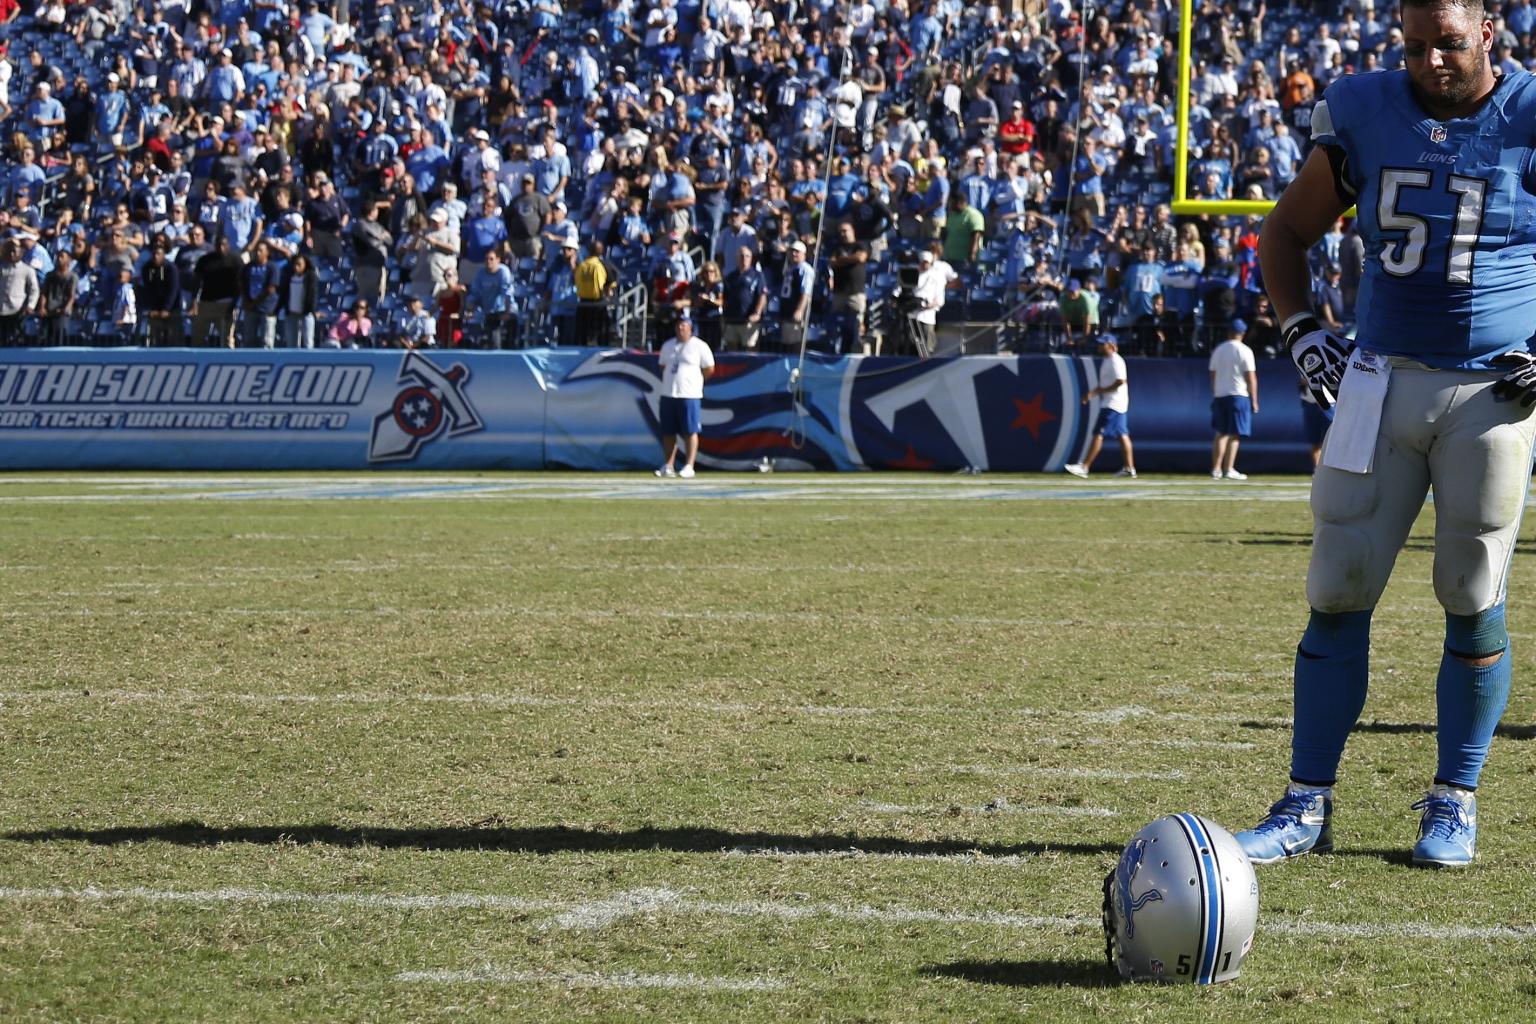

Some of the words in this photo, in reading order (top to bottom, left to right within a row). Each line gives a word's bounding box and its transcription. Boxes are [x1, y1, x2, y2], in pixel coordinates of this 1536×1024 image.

[1416, 151, 1459, 165] LIONS
[1376, 167, 1488, 286] 51
[1352, 361, 1378, 375] Wilson
[0, 363, 374, 406] ITANSONLINE.COM
[0, 411, 35, 430] OR
[37, 410, 126, 430] TICKET
[126, 410, 229, 430] WAITING
[230, 411, 288, 430] LIST
[288, 411, 349, 430] INFO
